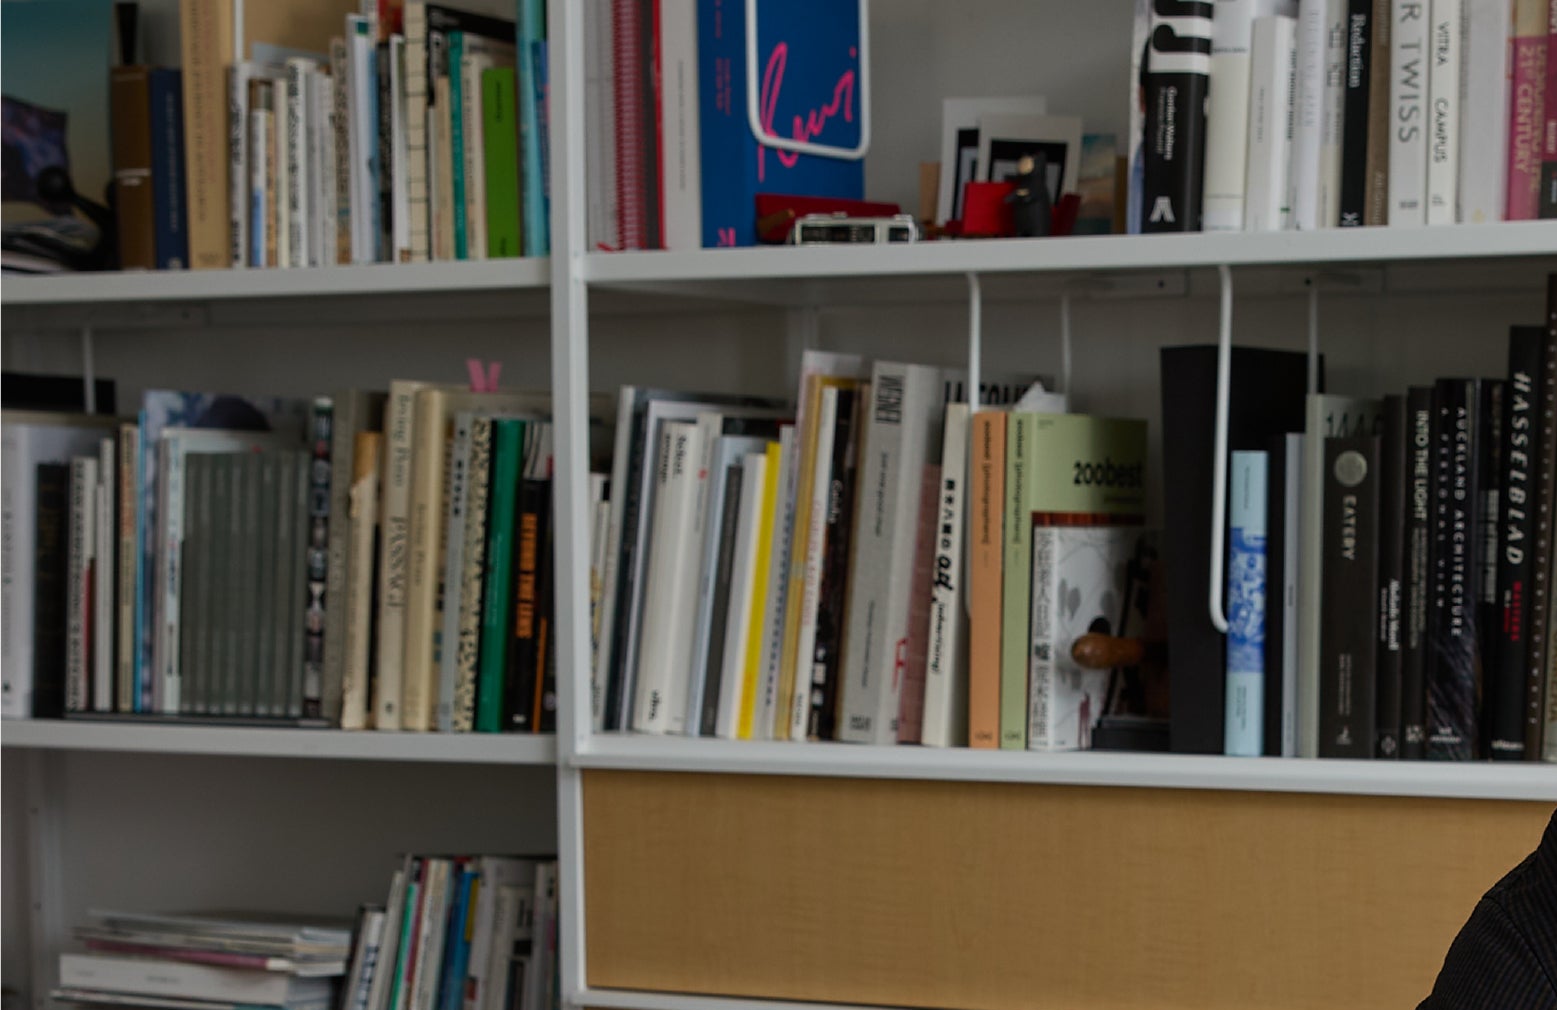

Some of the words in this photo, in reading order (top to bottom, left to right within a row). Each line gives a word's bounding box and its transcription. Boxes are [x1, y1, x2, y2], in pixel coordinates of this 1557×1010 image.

[1349, 13, 1367, 88] Redaction
[1435, 22, 1449, 66] VITRA
[1398, 40, 1421, 144] TWISS
[1433, 98, 1449, 163] CAMPUS
[1515, 83, 1534, 174] CENTURY
[1414, 409, 1430, 447] INTO
[1453, 406, 1467, 501] AUCKLAND
[1073, 457, 1144, 488] 200best
[1414, 448, 1429, 478] THE
[1506, 371, 1532, 566] HASSELBLAD
[1342, 495, 1357, 561] EATERY
[1413, 478, 1429, 521] LIGHT
[1450, 509, 1466, 637] ARCHITECTURE
